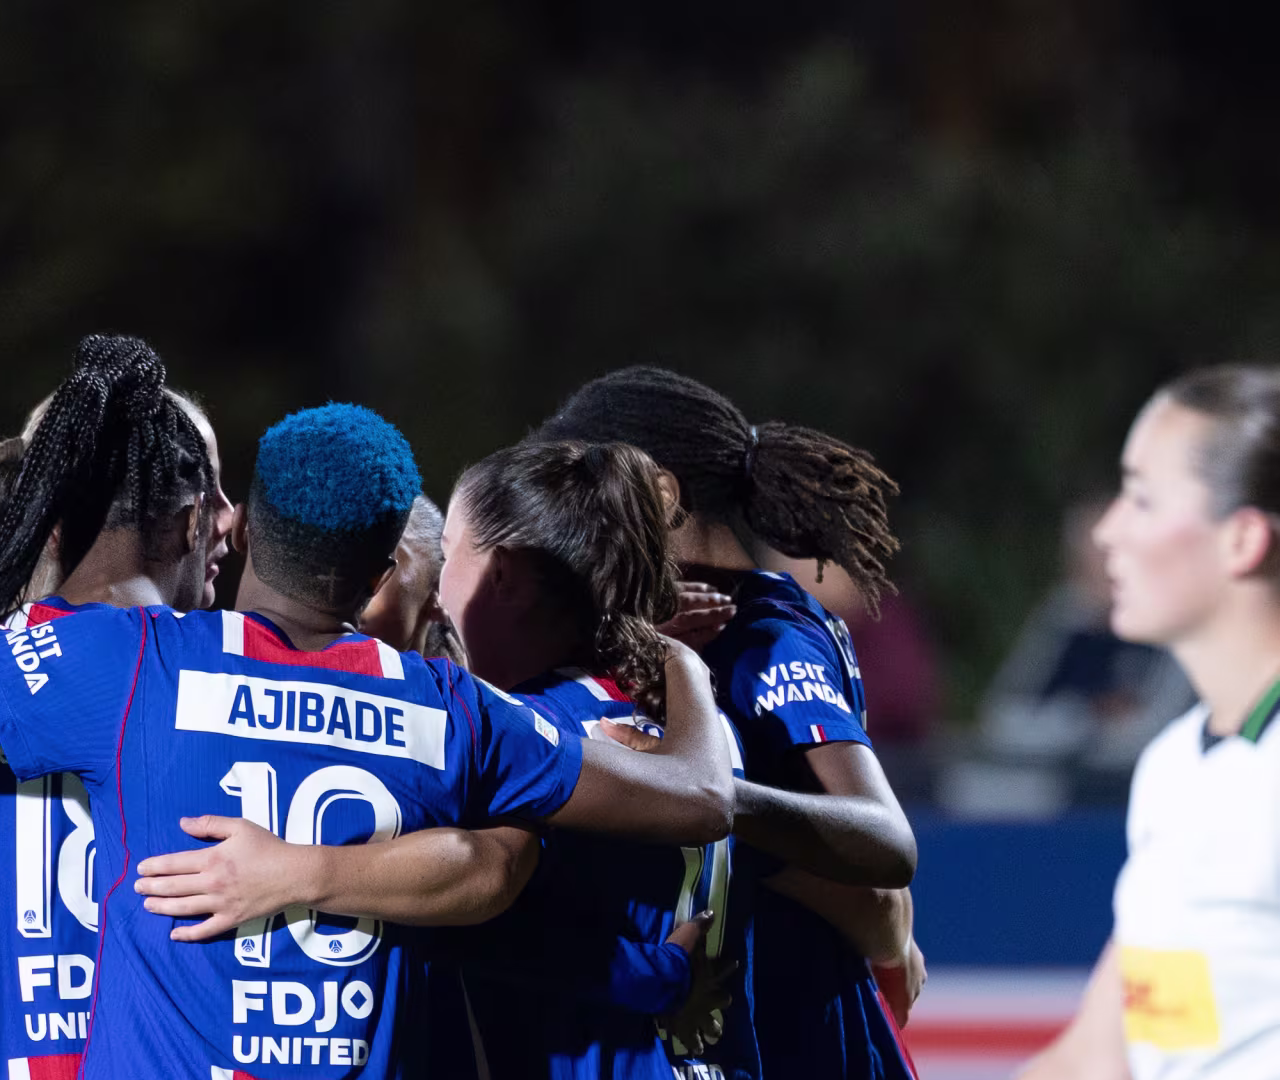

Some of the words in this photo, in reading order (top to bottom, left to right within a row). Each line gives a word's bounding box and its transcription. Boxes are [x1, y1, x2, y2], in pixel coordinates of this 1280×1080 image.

[757, 660, 826, 687] VISIT
[756, 681, 852, 713] WANDA
[227, 684, 406, 748] AJIBADE
[219, 761, 403, 967] 10
[18, 954, 95, 1003] FD
[24, 1012, 91, 1041] UNI
[232, 1035, 370, 1067] UNITED
